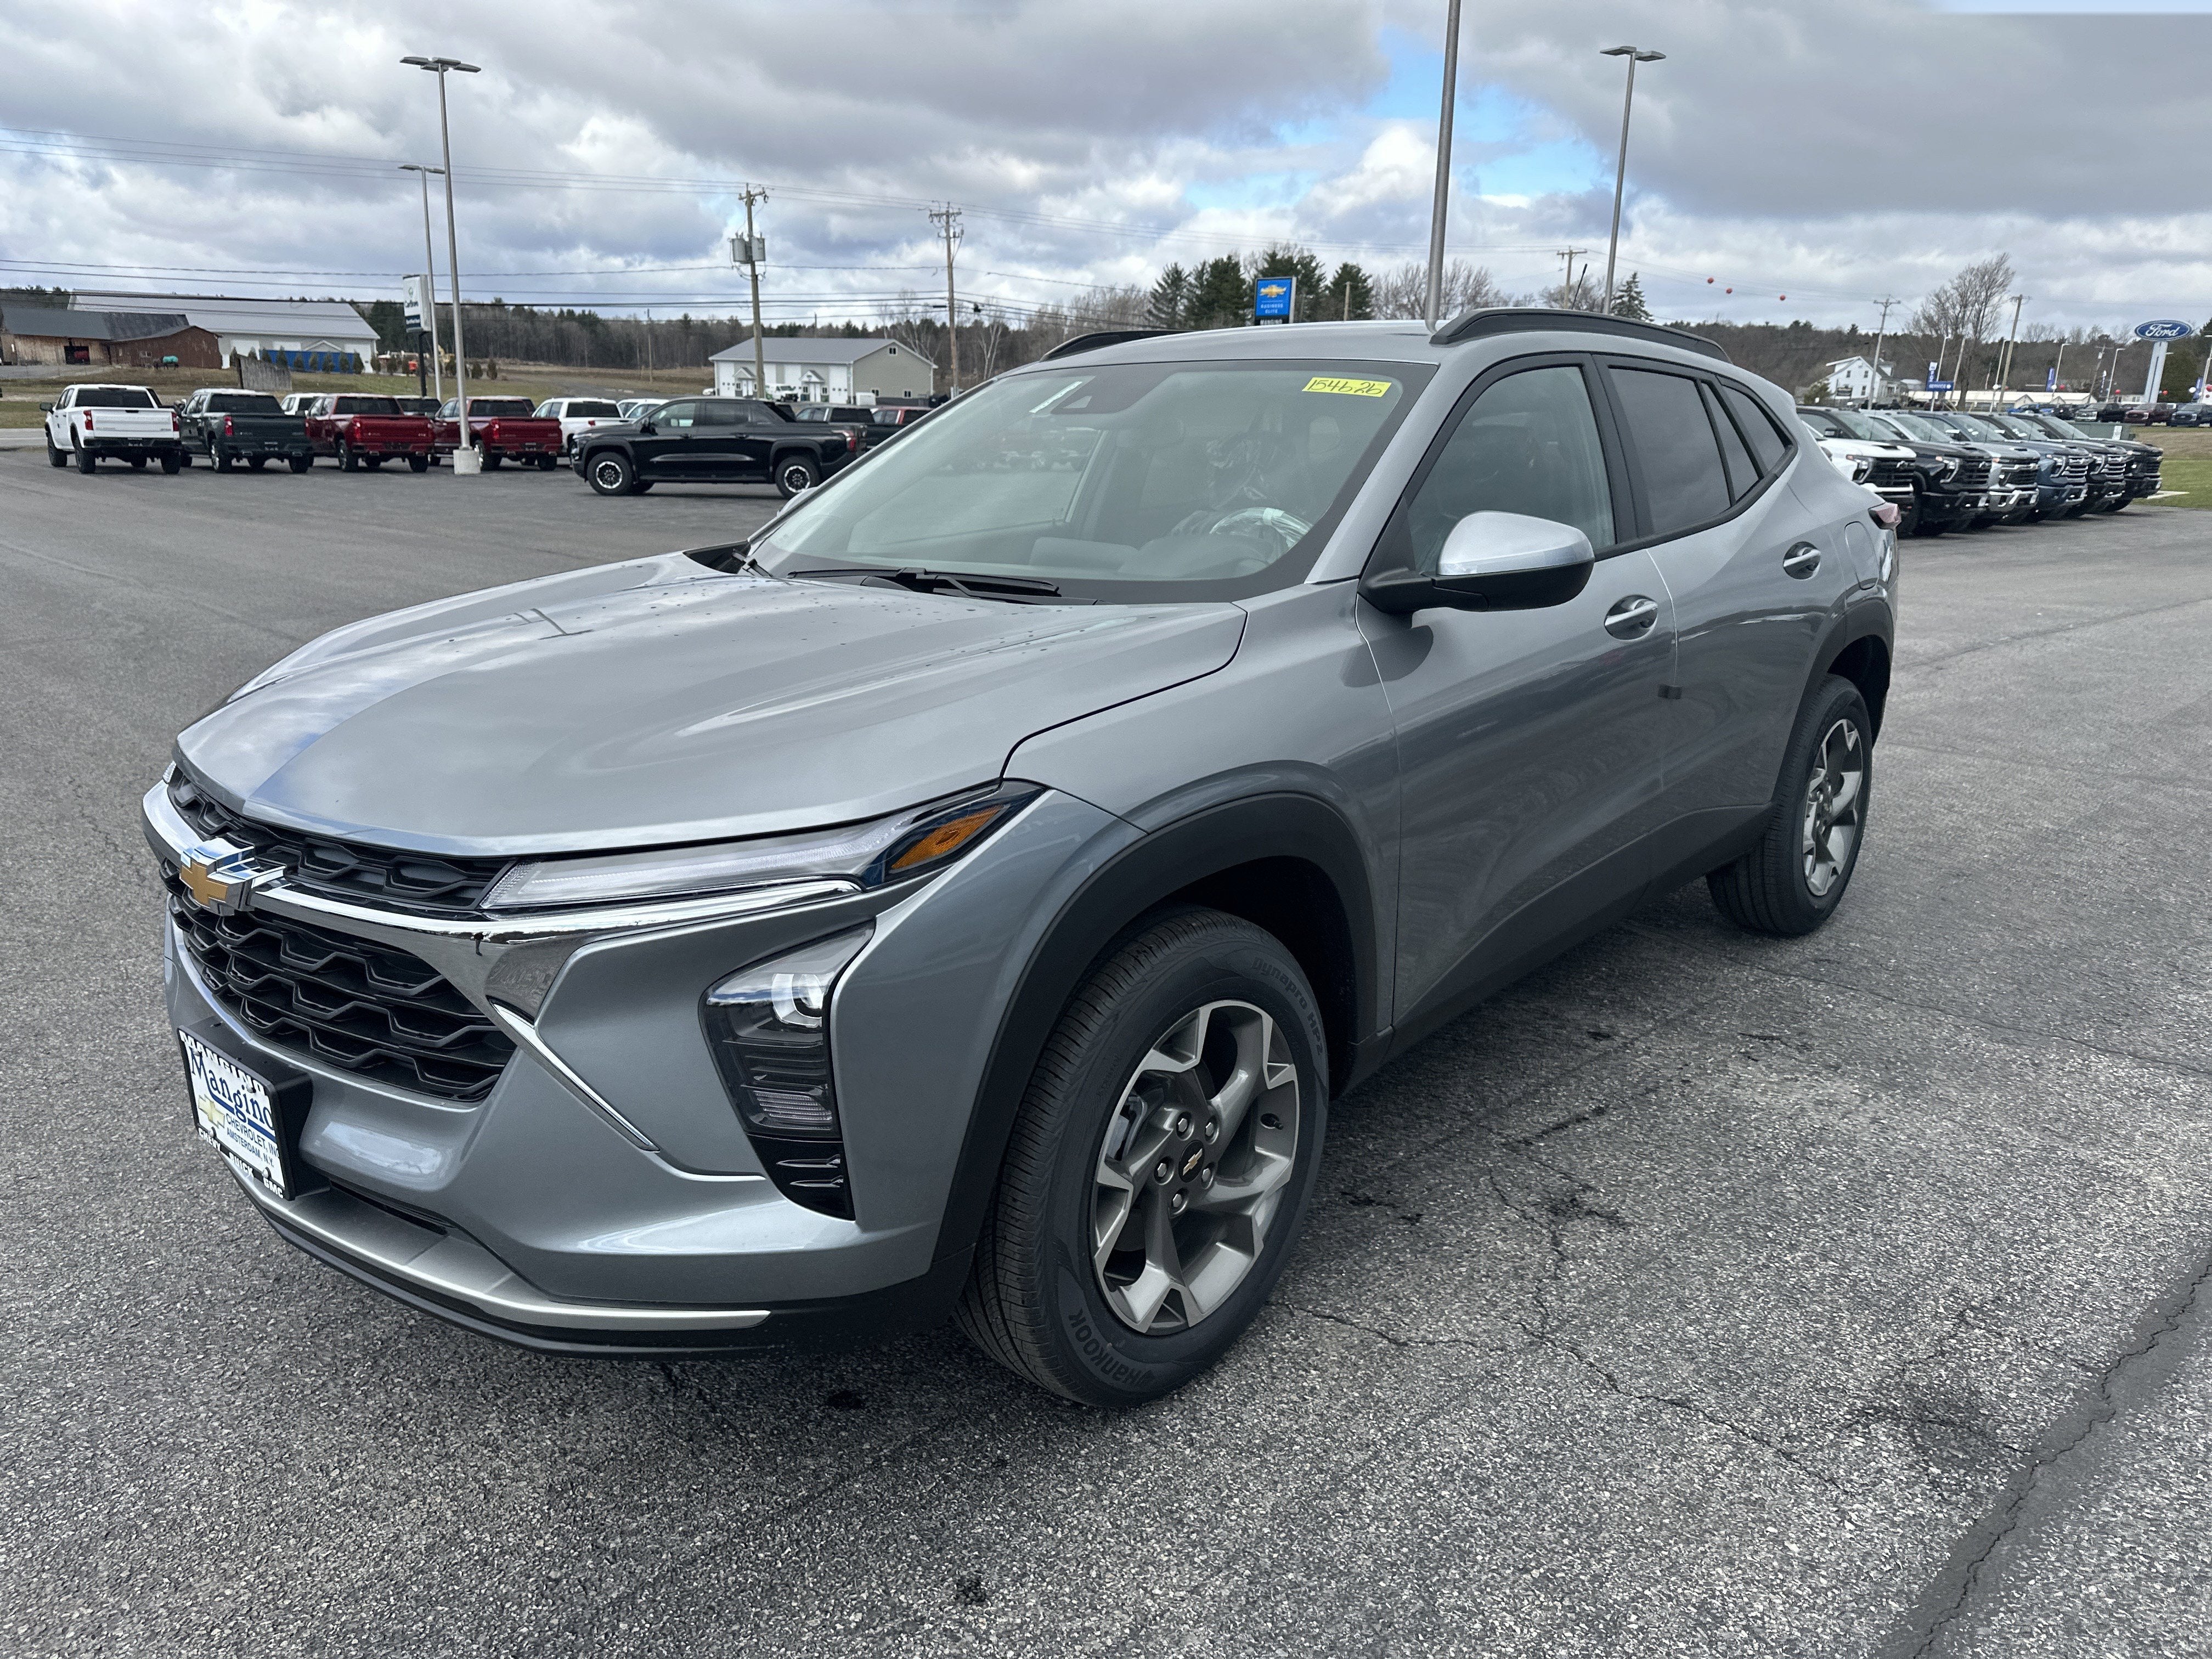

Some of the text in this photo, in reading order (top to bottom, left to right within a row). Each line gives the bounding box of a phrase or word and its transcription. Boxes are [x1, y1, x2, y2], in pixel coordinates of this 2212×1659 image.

[2145, 324, 2181, 336] Ford
[178, 1029, 268, 1096] MANGINO
[190, 1045, 274, 1131] Mangino
[198, 1127, 221, 1152] CHEVY
[229, 1152, 255, 1178] BUICK
[263, 1177, 284, 1199] GMC
